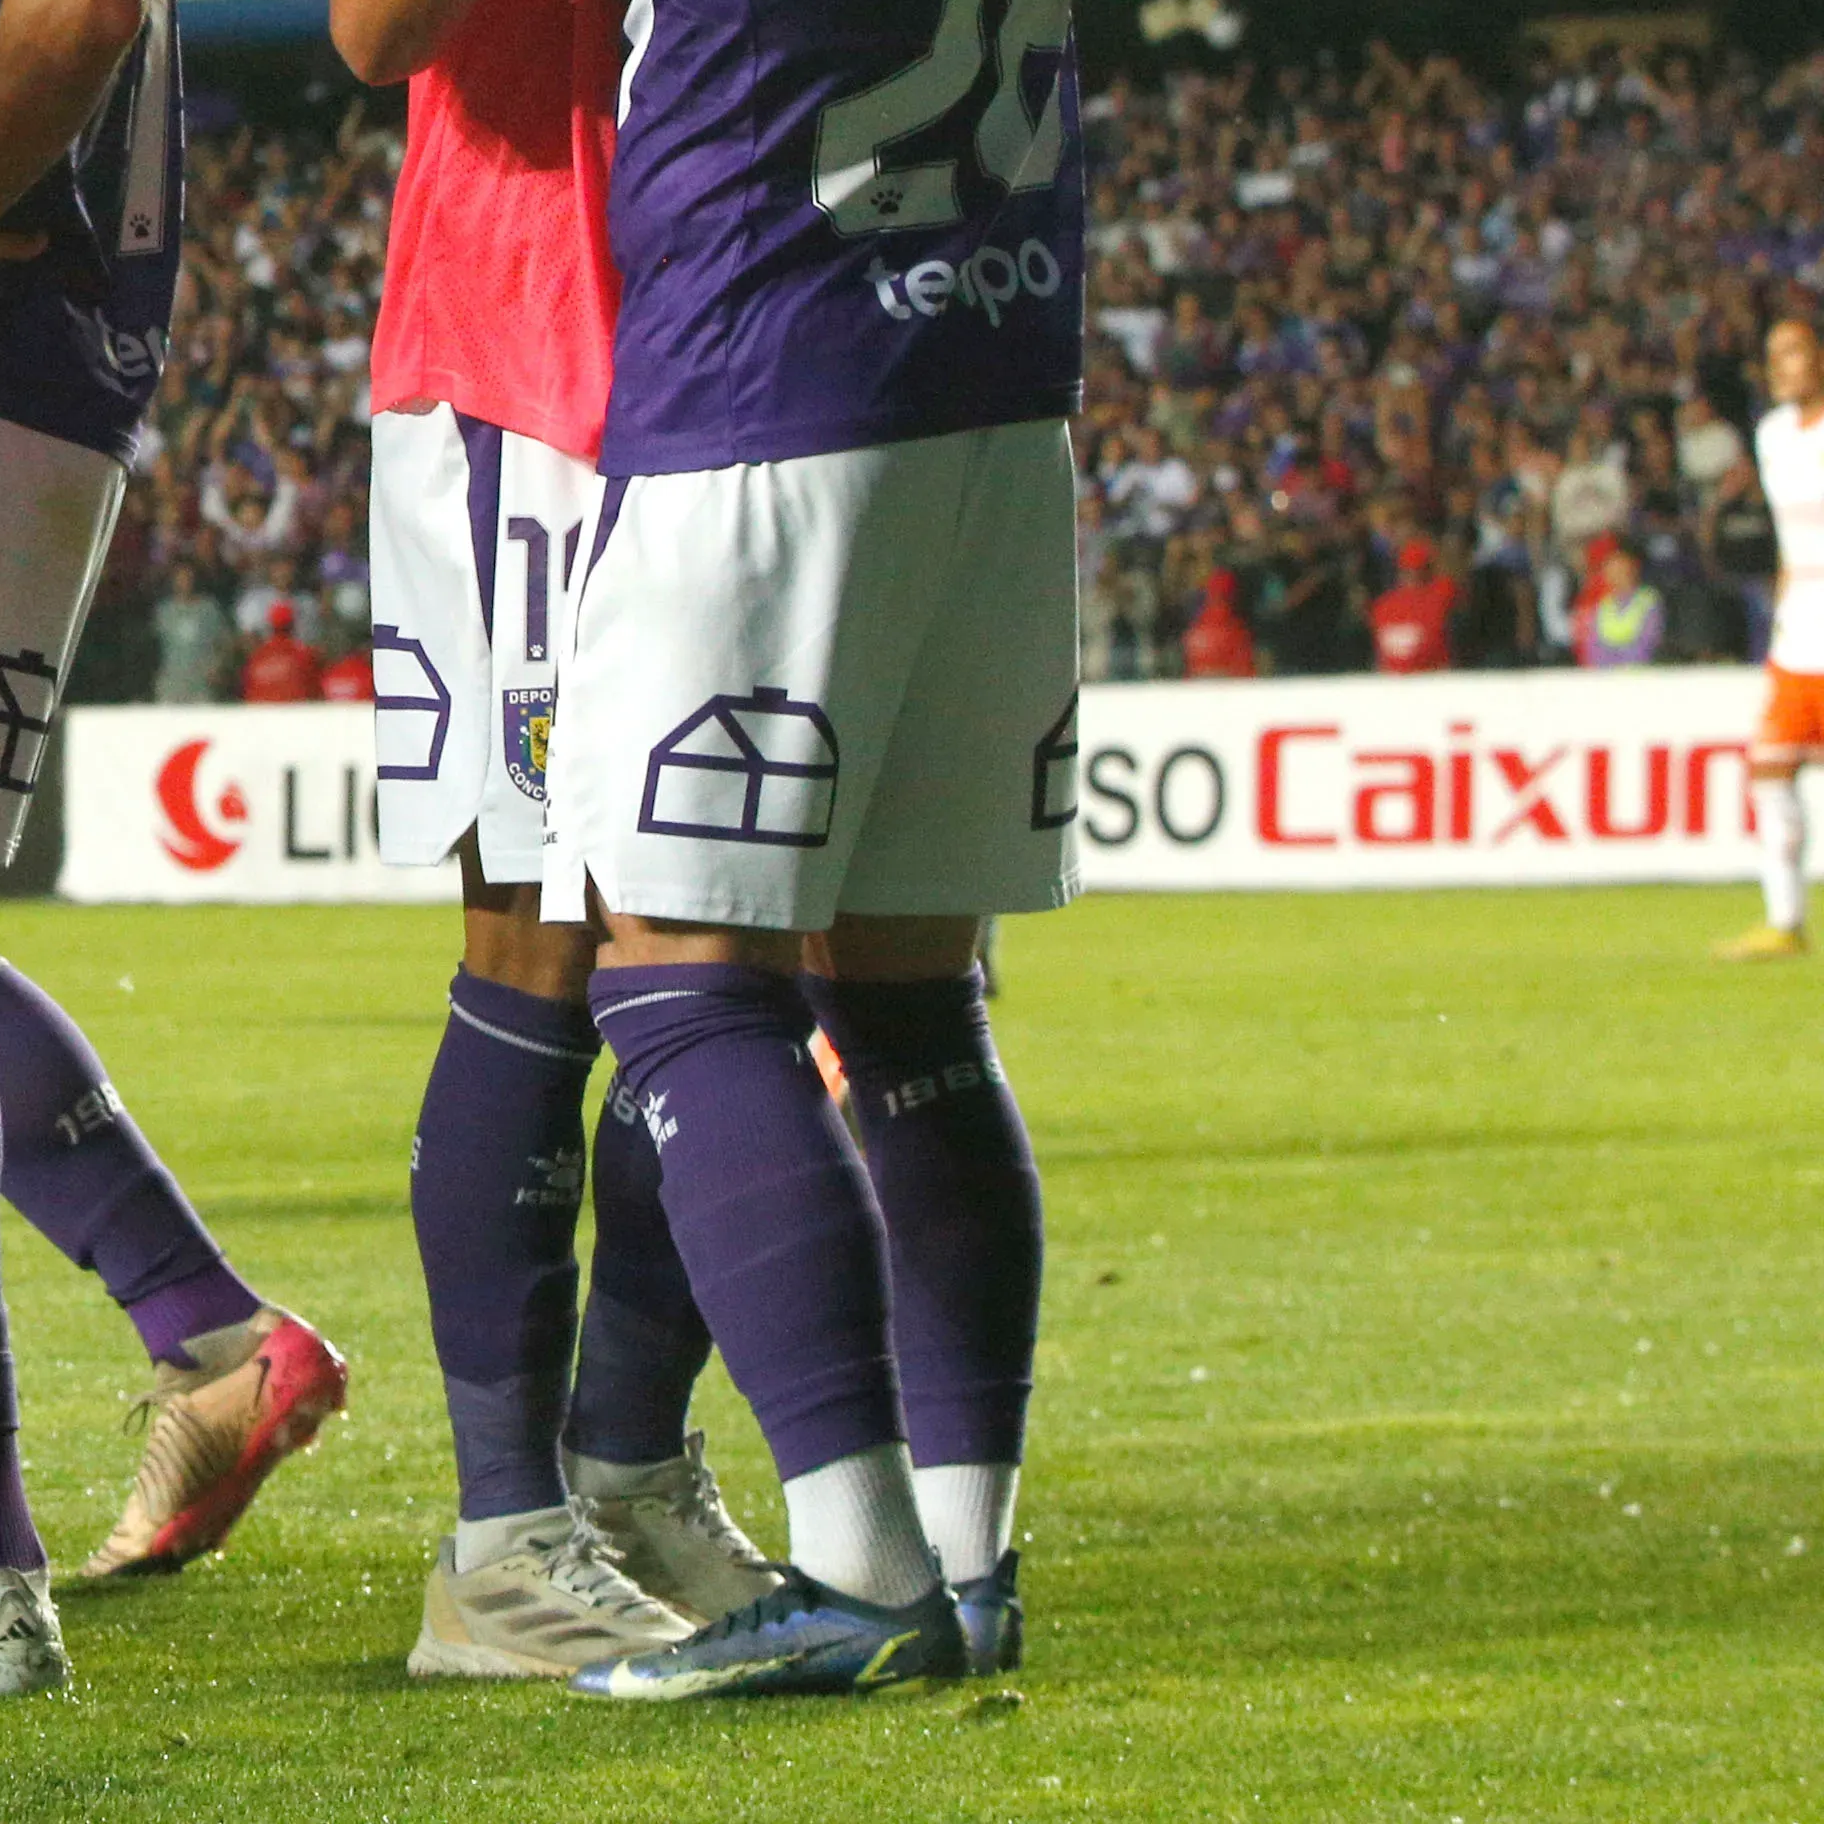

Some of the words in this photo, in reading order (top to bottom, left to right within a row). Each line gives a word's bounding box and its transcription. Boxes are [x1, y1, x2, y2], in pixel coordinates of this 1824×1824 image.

[508, 690, 552, 705] DEPO
[284, 763, 378, 861] LI
[1253, 722, 1758, 847] Caixun
